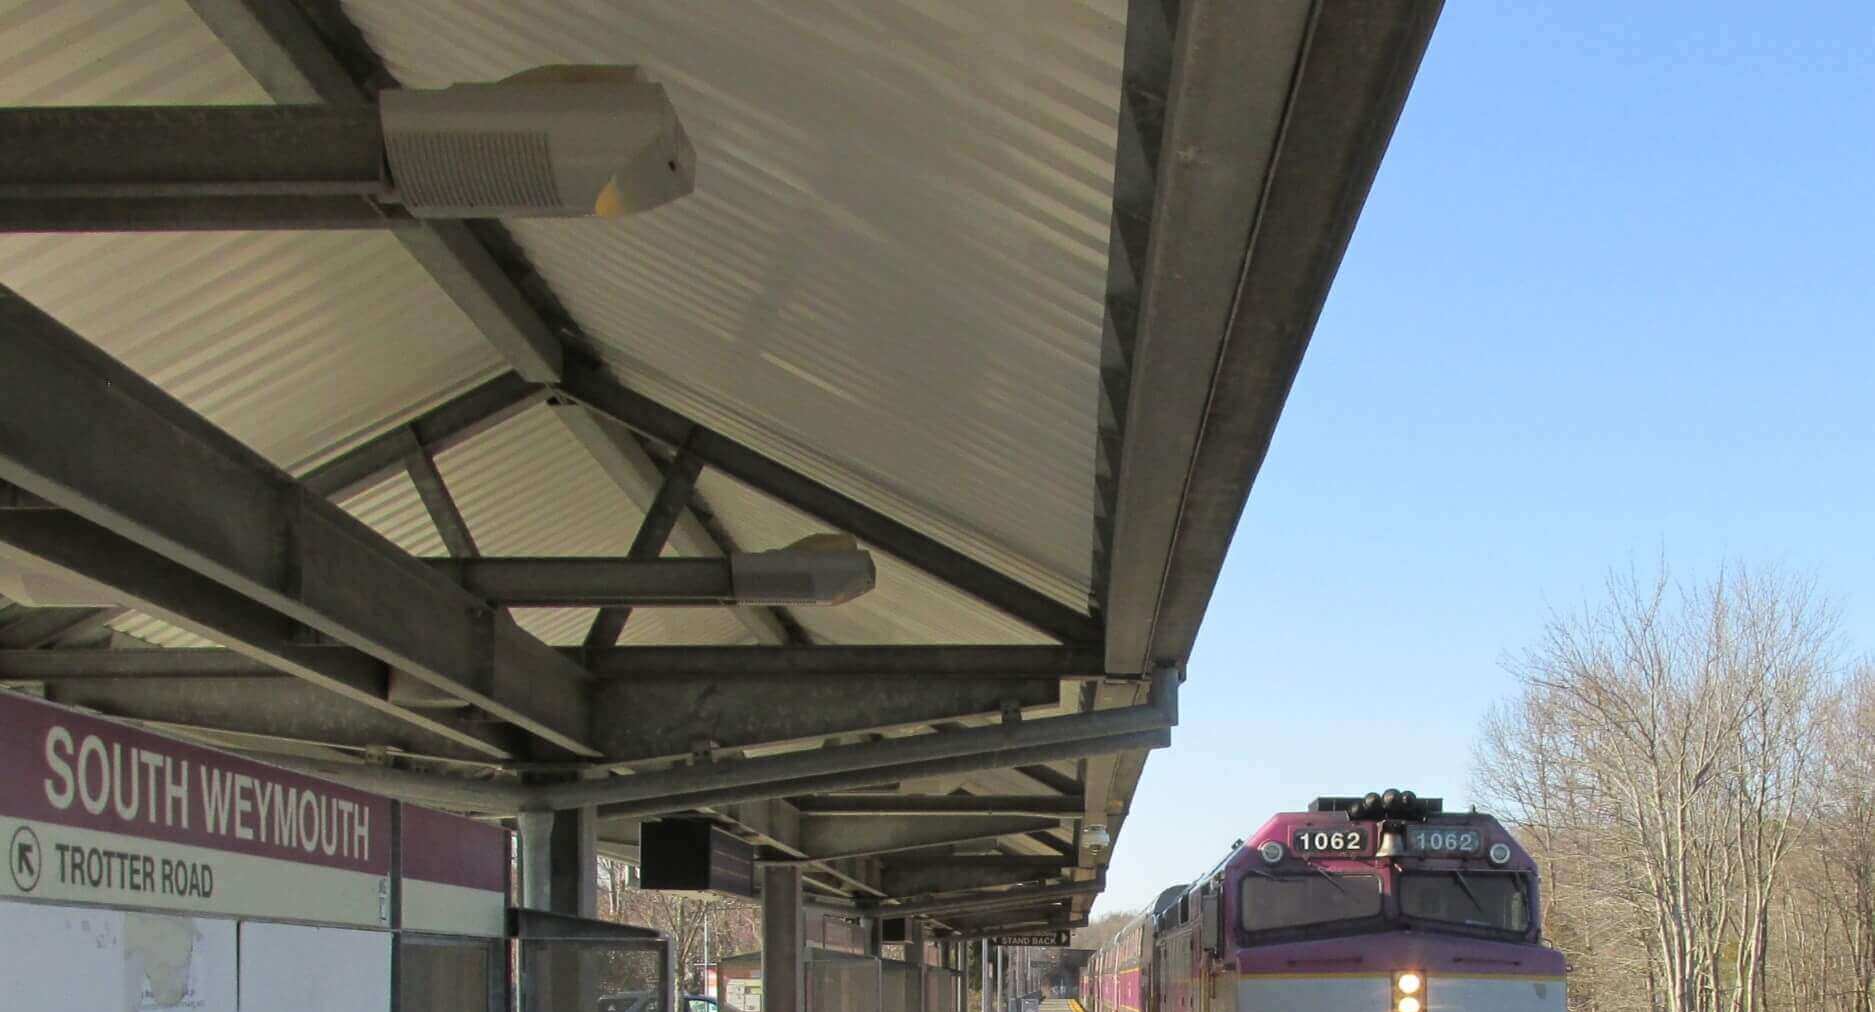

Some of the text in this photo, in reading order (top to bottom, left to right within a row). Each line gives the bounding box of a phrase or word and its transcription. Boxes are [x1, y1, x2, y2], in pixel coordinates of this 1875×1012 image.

[44, 726, 371, 861] SOUTH WEYMOUTH
[1300, 832, 1361, 850] 1062
[1416, 833, 1473, 850] 1062
[55, 843, 214, 899] TROTTER ROAD
[1001, 936, 1057, 945] STAND BACK
